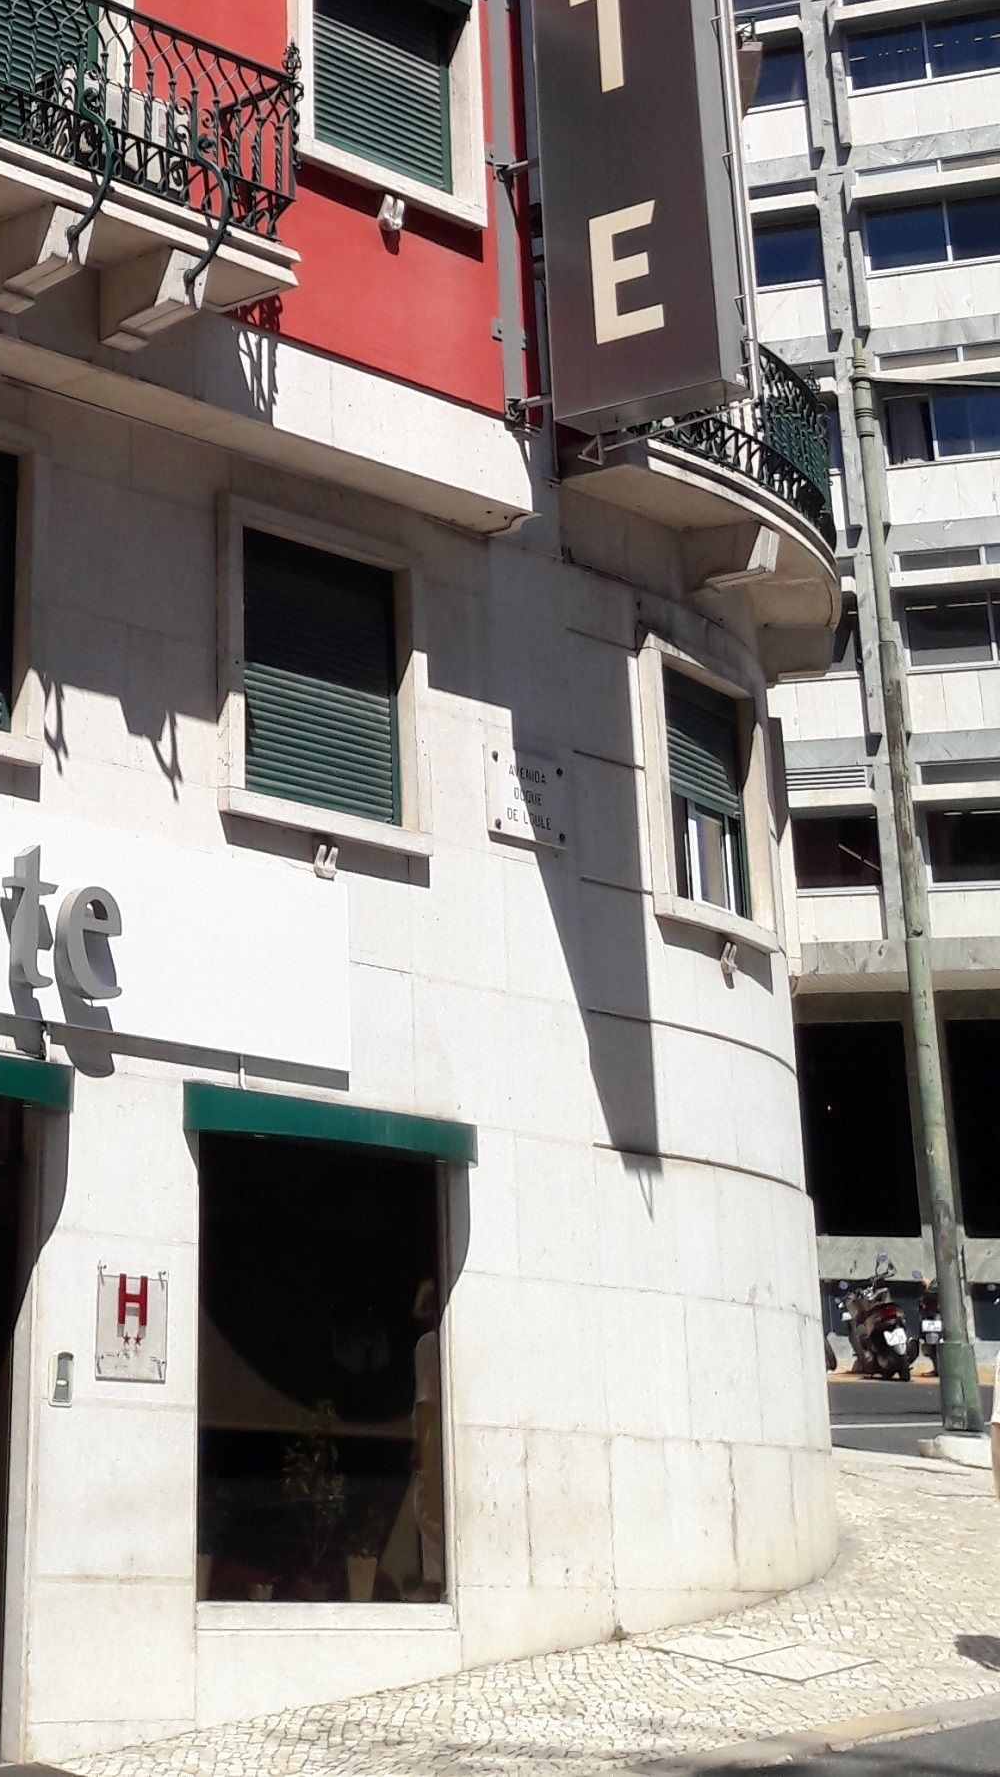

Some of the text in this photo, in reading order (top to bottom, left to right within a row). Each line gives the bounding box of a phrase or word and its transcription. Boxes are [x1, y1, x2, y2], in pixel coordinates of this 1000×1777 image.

[508, 763, 547, 785] AVENIDA
[514, 787, 542, 806] DUQUE
[506, 807, 519, 822] DE
[117, 1272, 148, 1328] H
